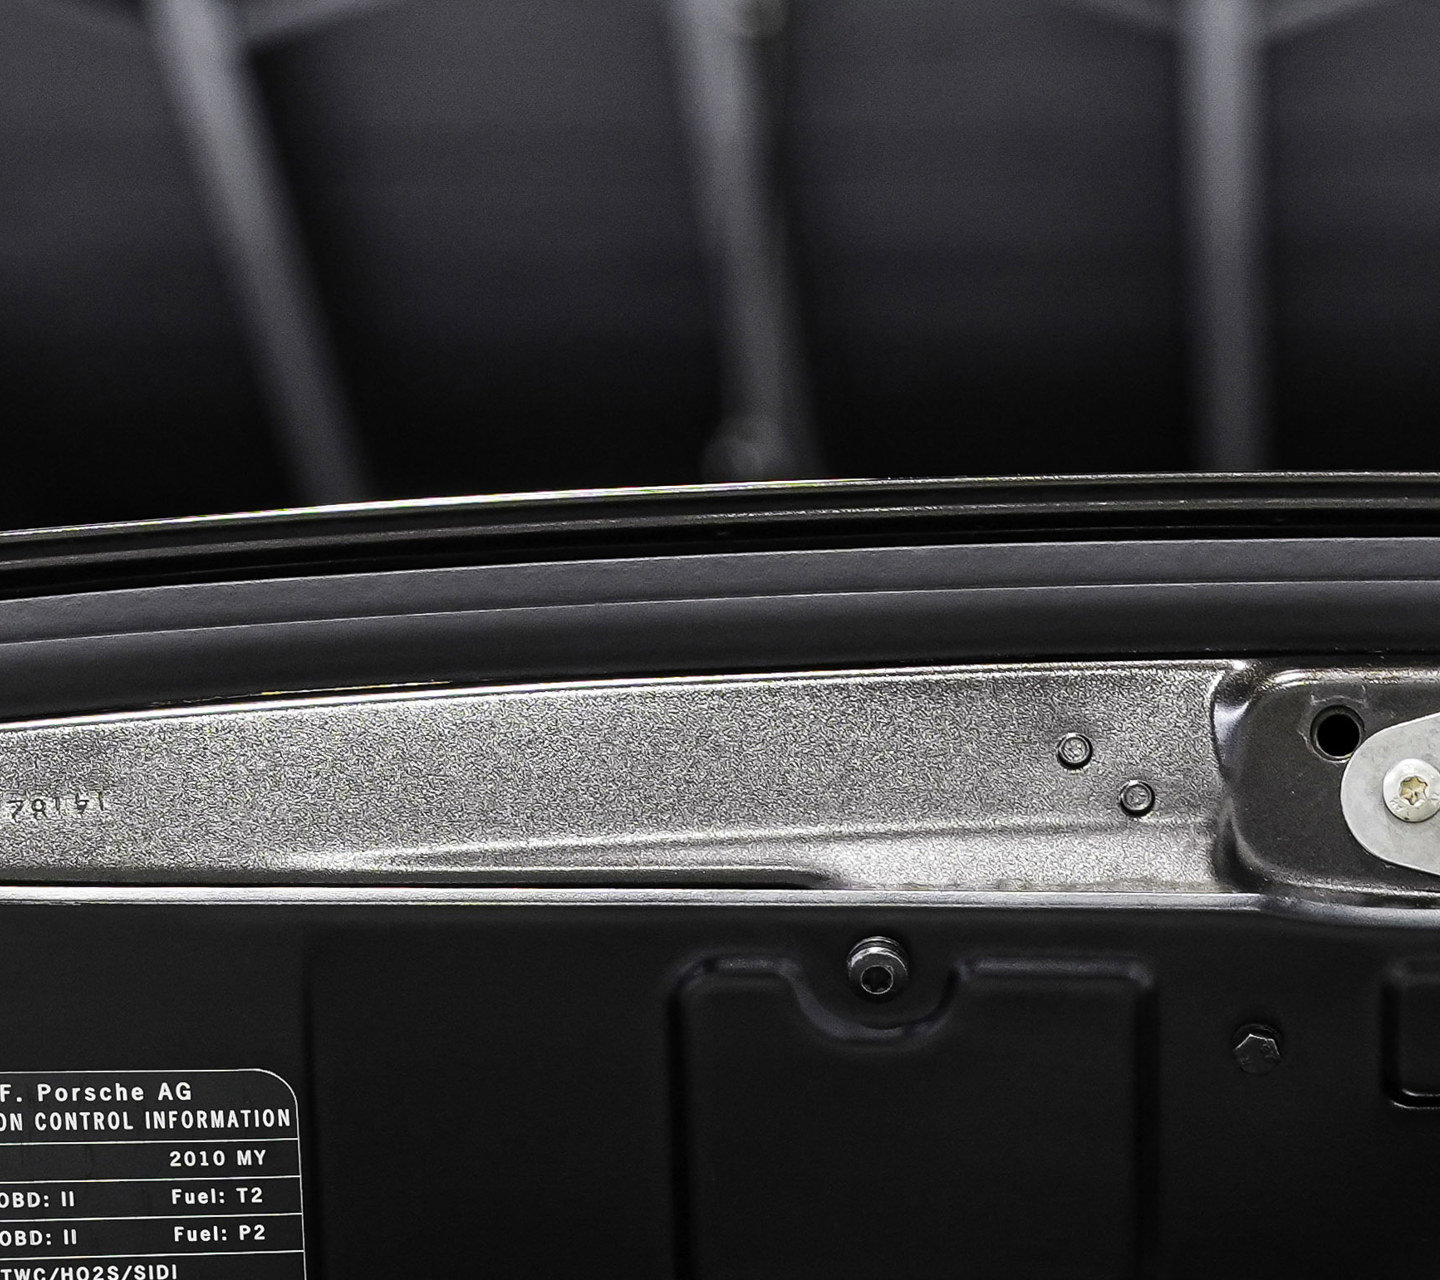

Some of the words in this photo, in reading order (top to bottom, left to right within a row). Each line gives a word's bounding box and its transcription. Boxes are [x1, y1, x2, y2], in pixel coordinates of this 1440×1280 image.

[0, 1084, 22, 1102] F.
[38, 1083, 143, 1101] Porsche
[158, 1082, 191, 1100] AG
[35, 1111, 133, 1130] CONTROL
[146, 1109, 290, 1129] INFORMATION
[170, 1150, 225, 1166] 2010
[237, 1150, 265, 1165] MY
[62, 1191, 74, 1206] II
[172, 1189, 224, 1204] Fuel:
[236, 1187, 262, 1203] T2
[0, 1230, 51, 1246] OBD:
[64, 1229, 76, 1245] II
[174, 1226, 226, 1241] Fuel:
[239, 1225, 265, 1240] P2
